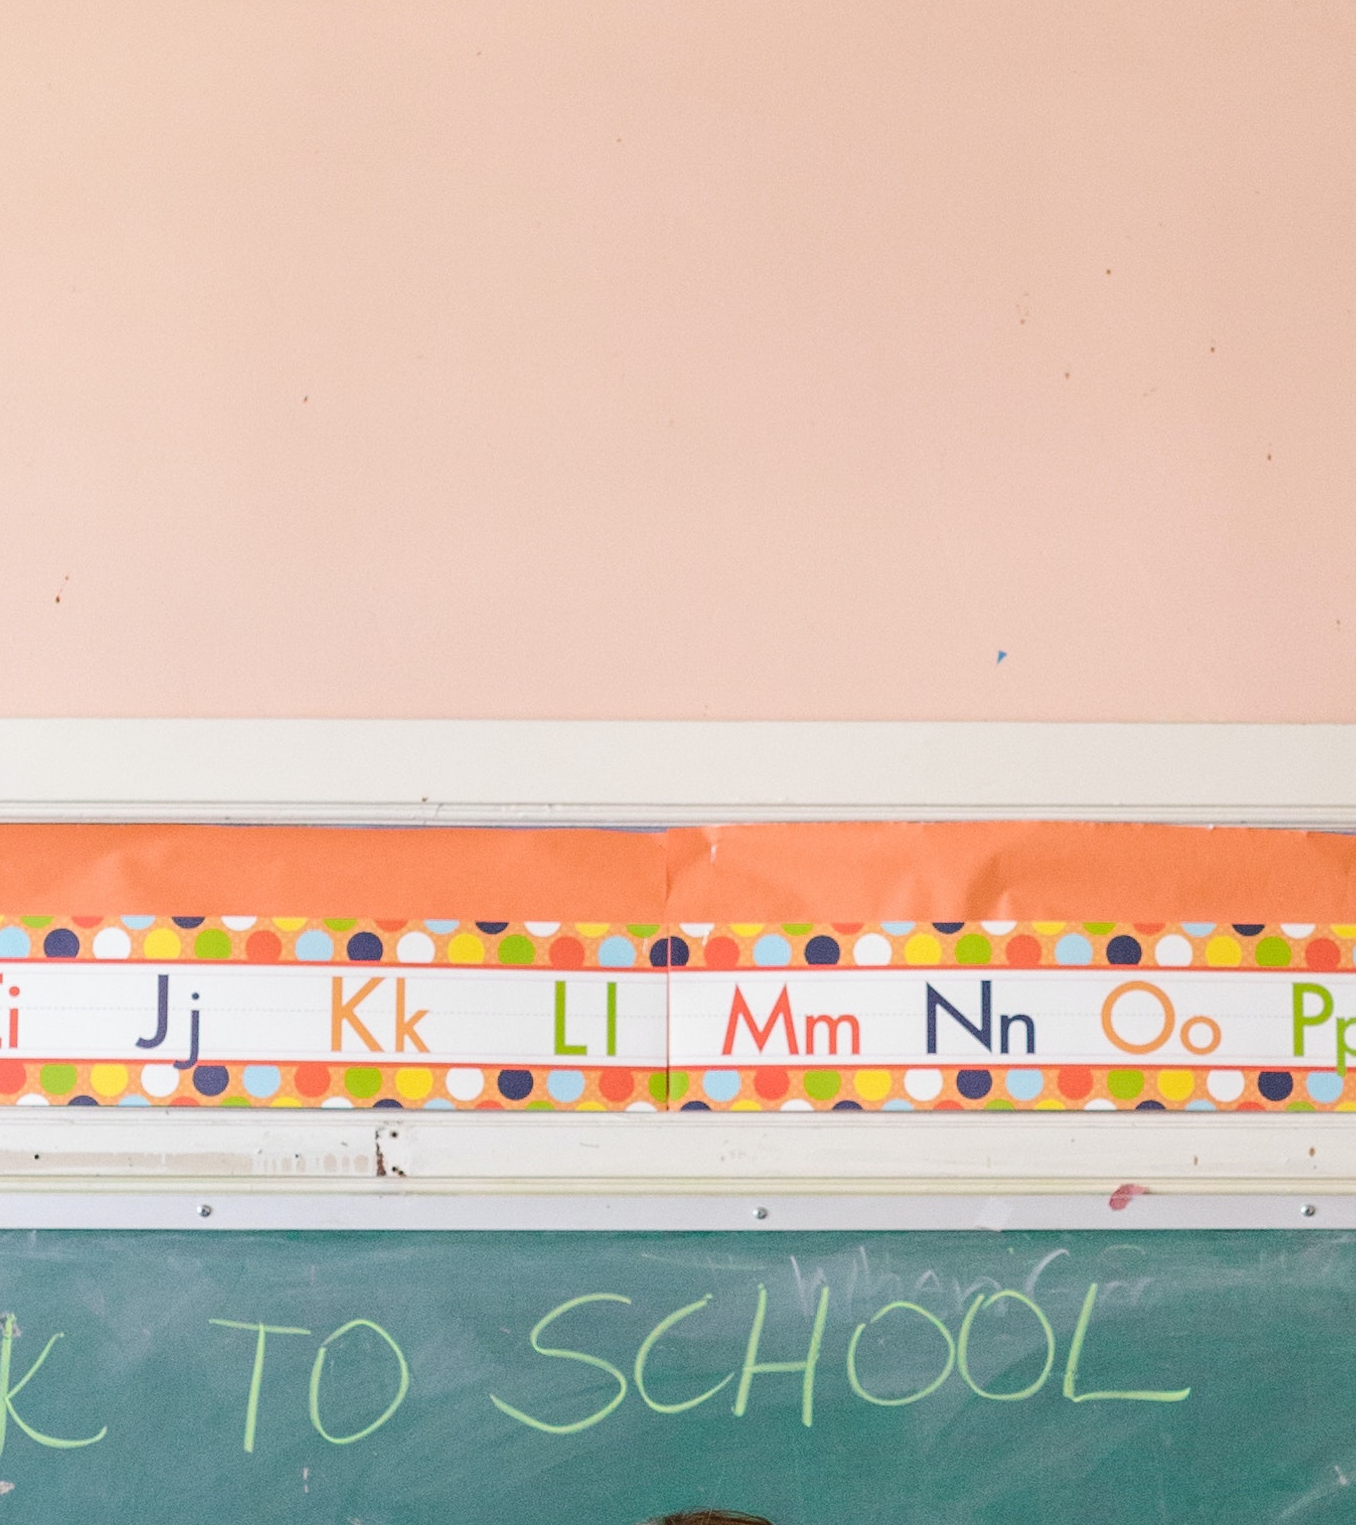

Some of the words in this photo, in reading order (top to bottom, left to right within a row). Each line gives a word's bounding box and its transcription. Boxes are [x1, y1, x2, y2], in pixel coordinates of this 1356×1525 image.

[135, 974, 200, 1069] Jj
[332, 977, 428, 1052] Kk
[554, 980, 617, 1057] Ll
[722, 986, 860, 1056] Mm
[926, 979, 1036, 1055] Nn
[1102, 981, 1221, 1055] Oo
[208, 1319, 409, 1453] TO
[489, 1283, 1191, 1434] SCHOOL
